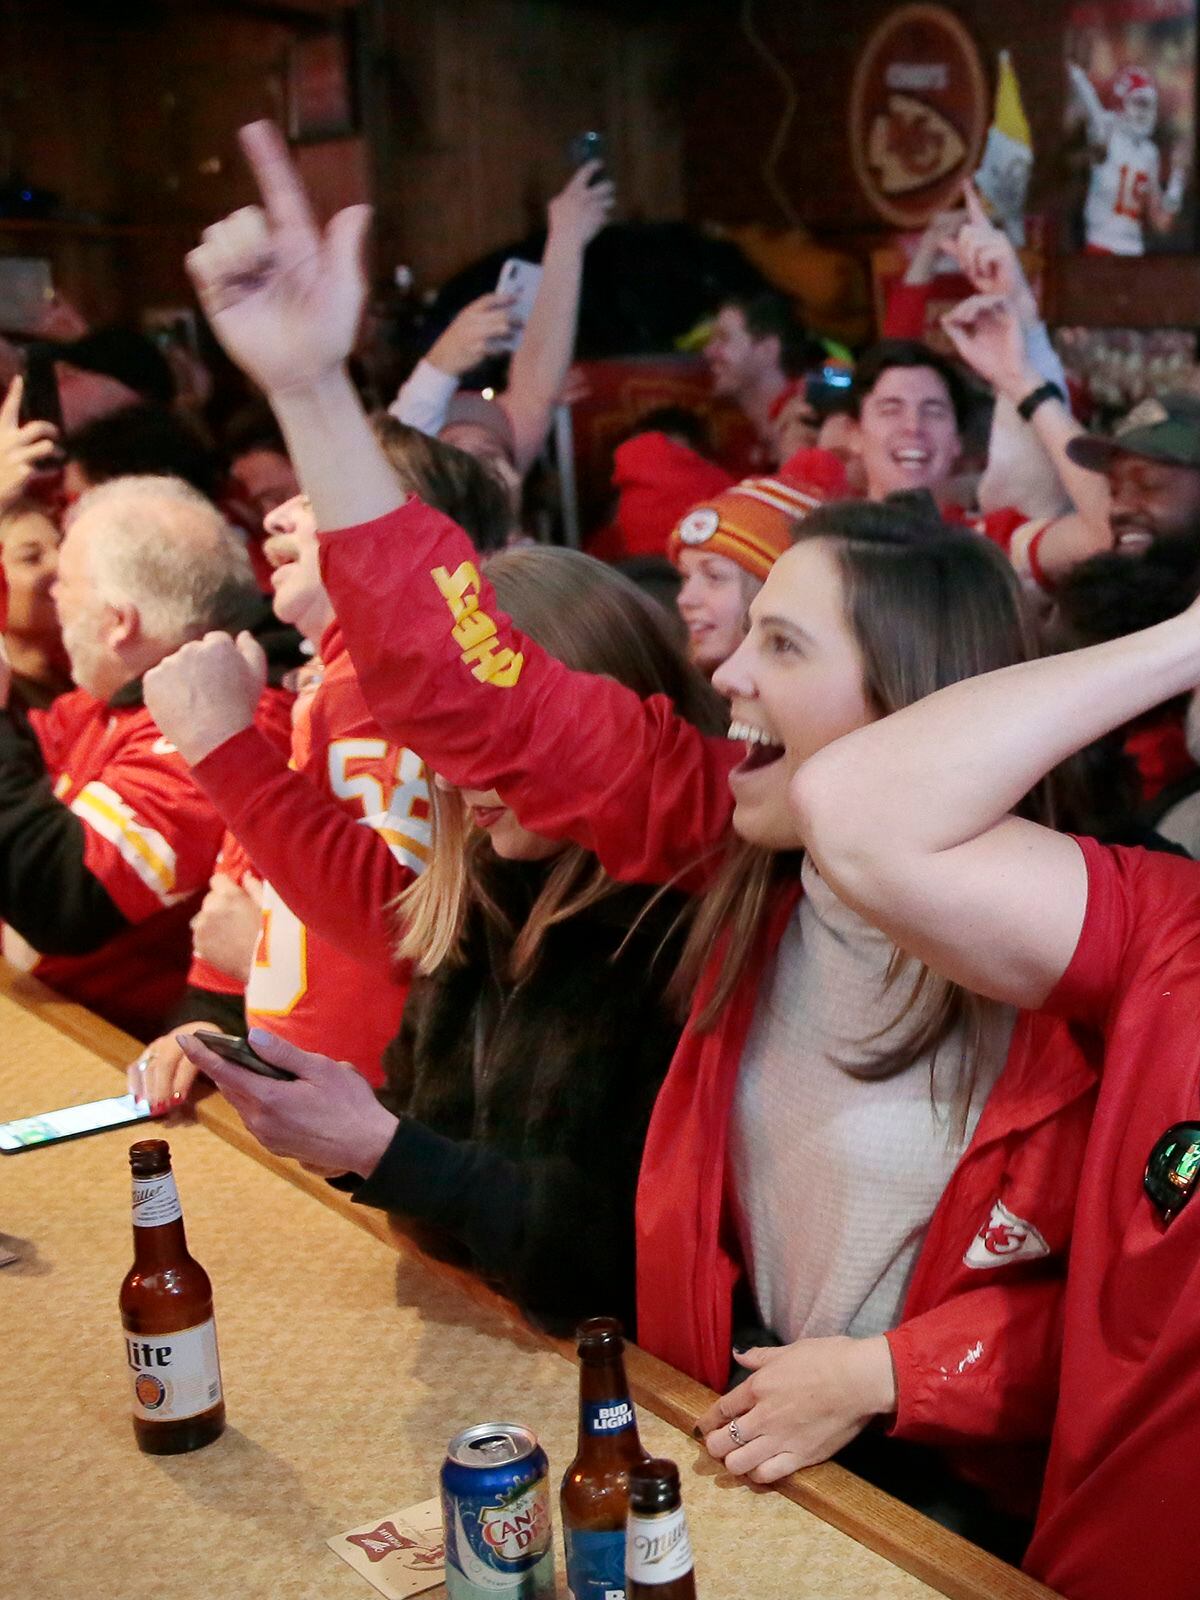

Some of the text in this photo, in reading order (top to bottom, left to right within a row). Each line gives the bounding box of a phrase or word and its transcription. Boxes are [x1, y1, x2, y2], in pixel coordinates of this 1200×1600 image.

[430, 560, 524, 688] CHEFS
[593, 1409, 633, 1430] LIGHT
[598, 1403, 629, 1419] BUD
[633, 1520, 687, 1561] Mill
